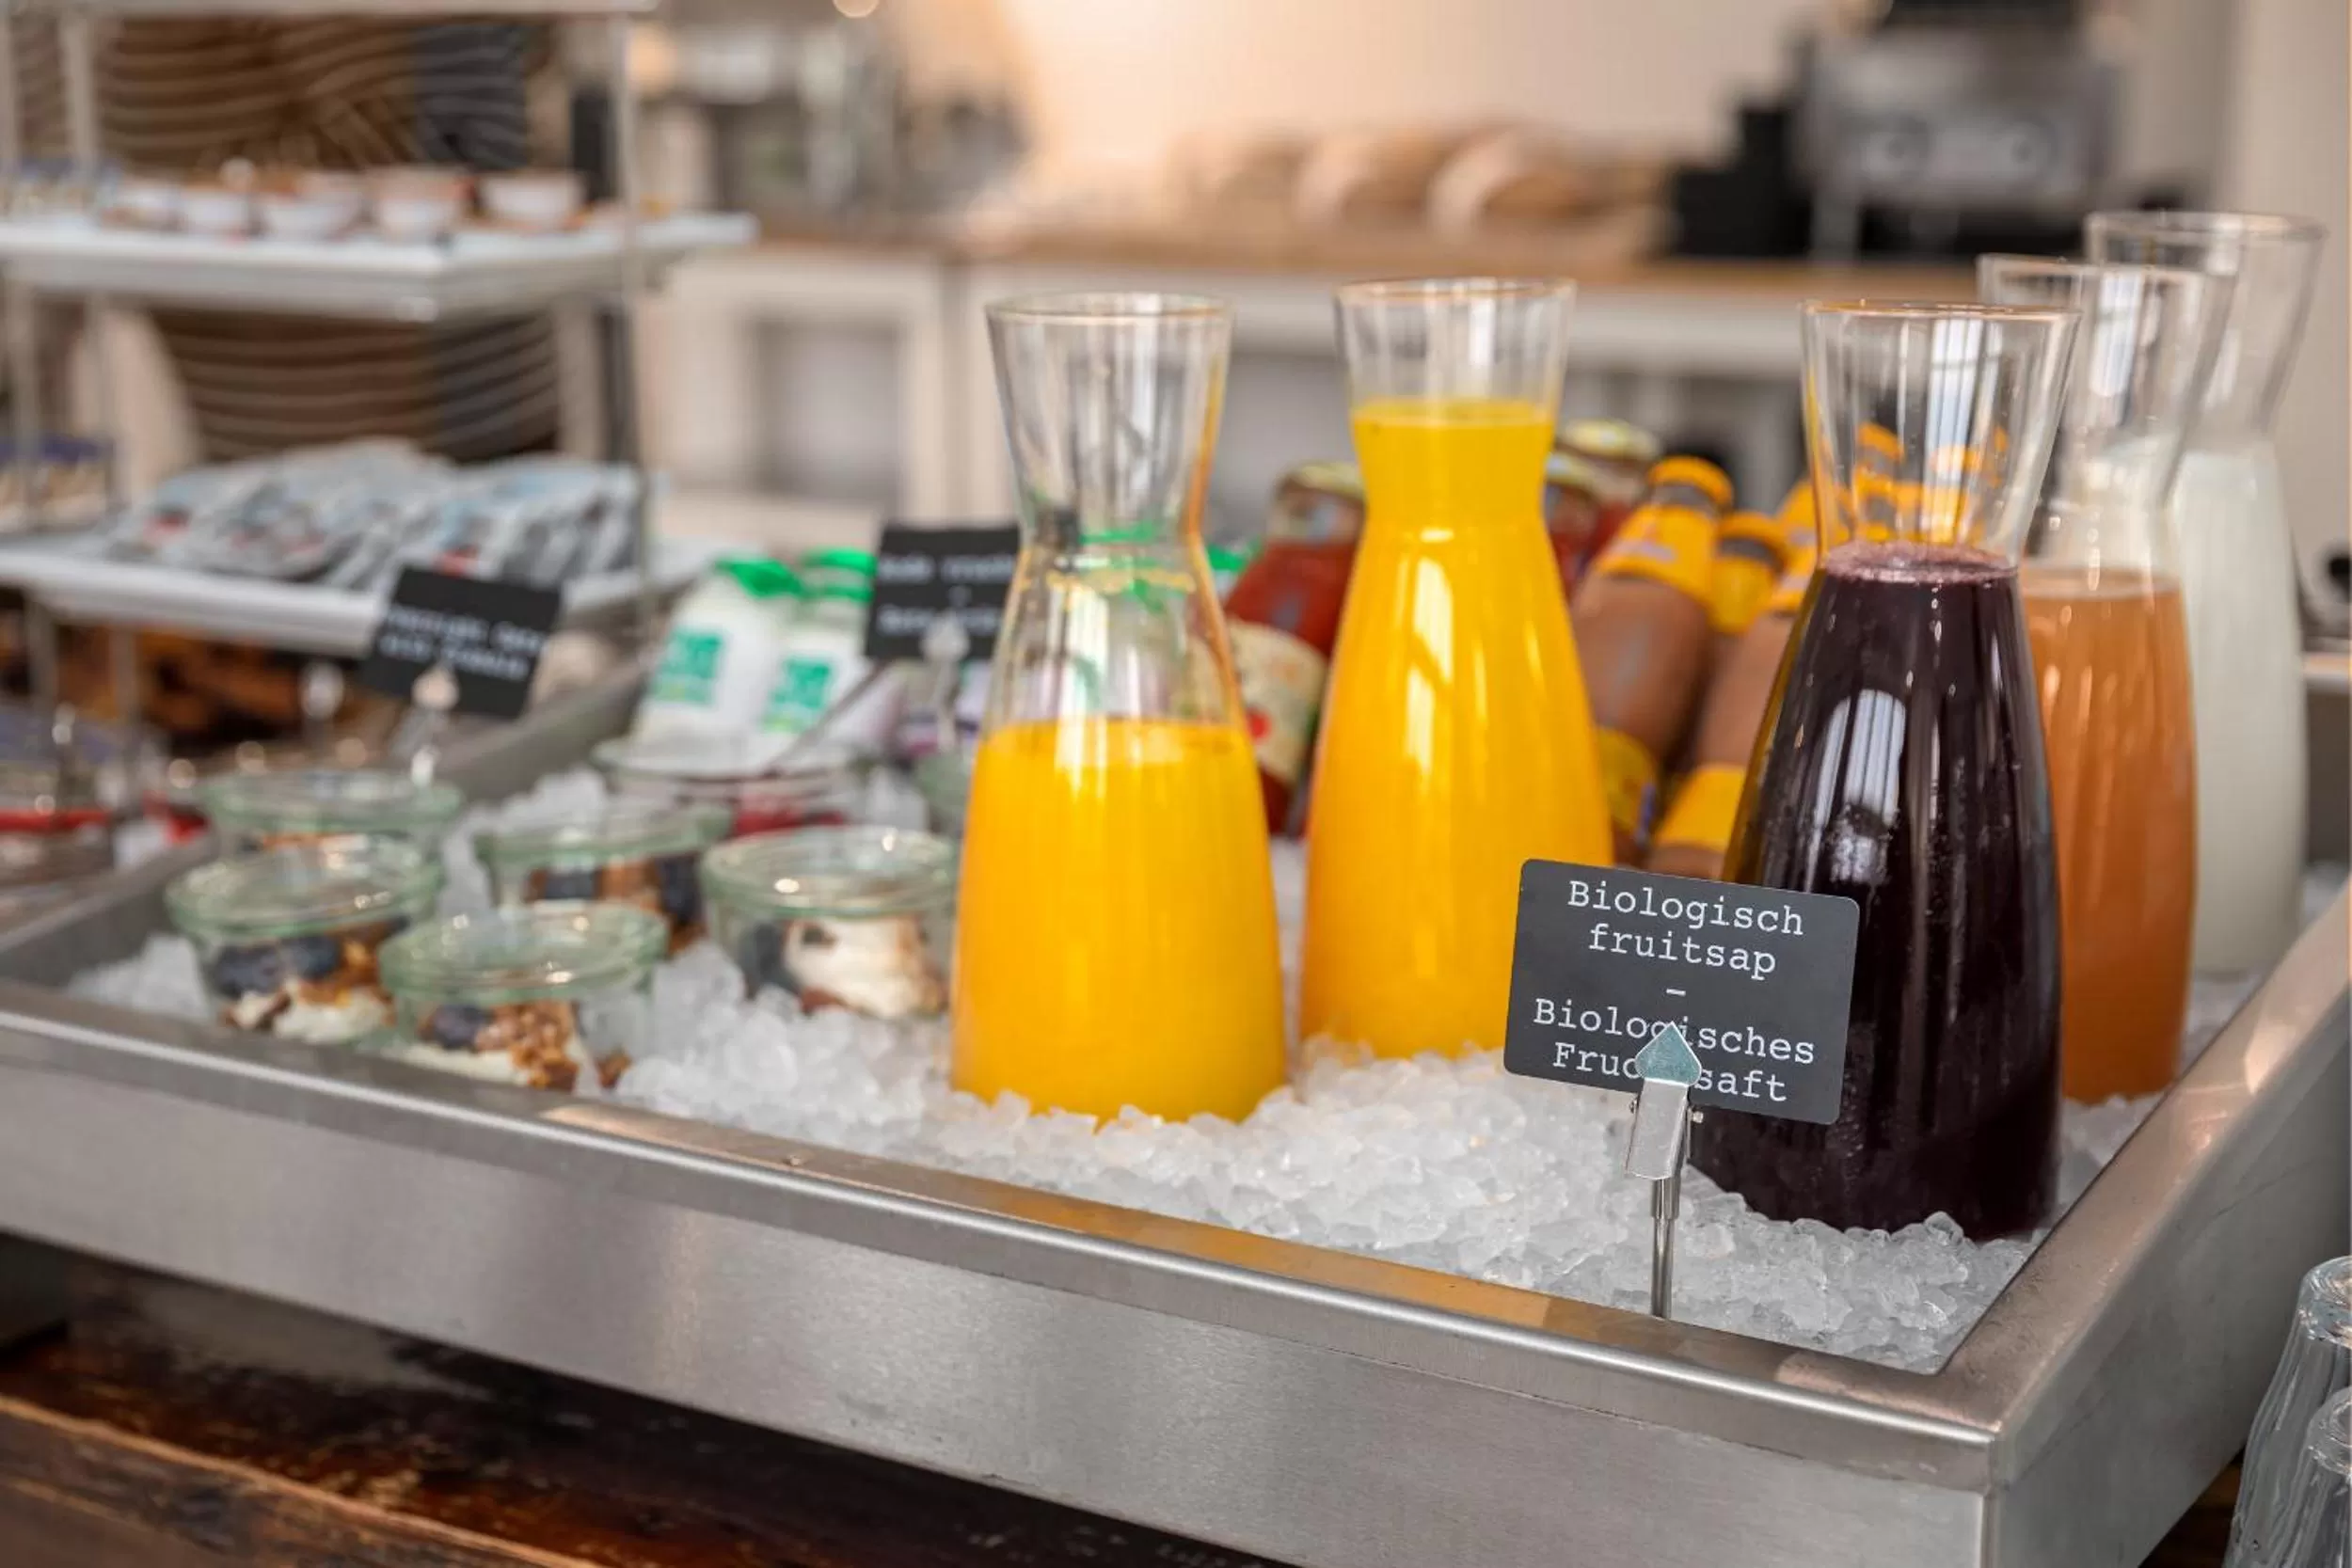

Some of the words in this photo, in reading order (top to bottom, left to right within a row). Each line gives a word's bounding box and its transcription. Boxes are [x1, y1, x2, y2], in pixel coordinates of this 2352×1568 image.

[1567, 880, 1804, 936] Biologisch
[1588, 924, 1777, 981] fruitsap
[1552, 1041, 1788, 1102] Frucsaft
